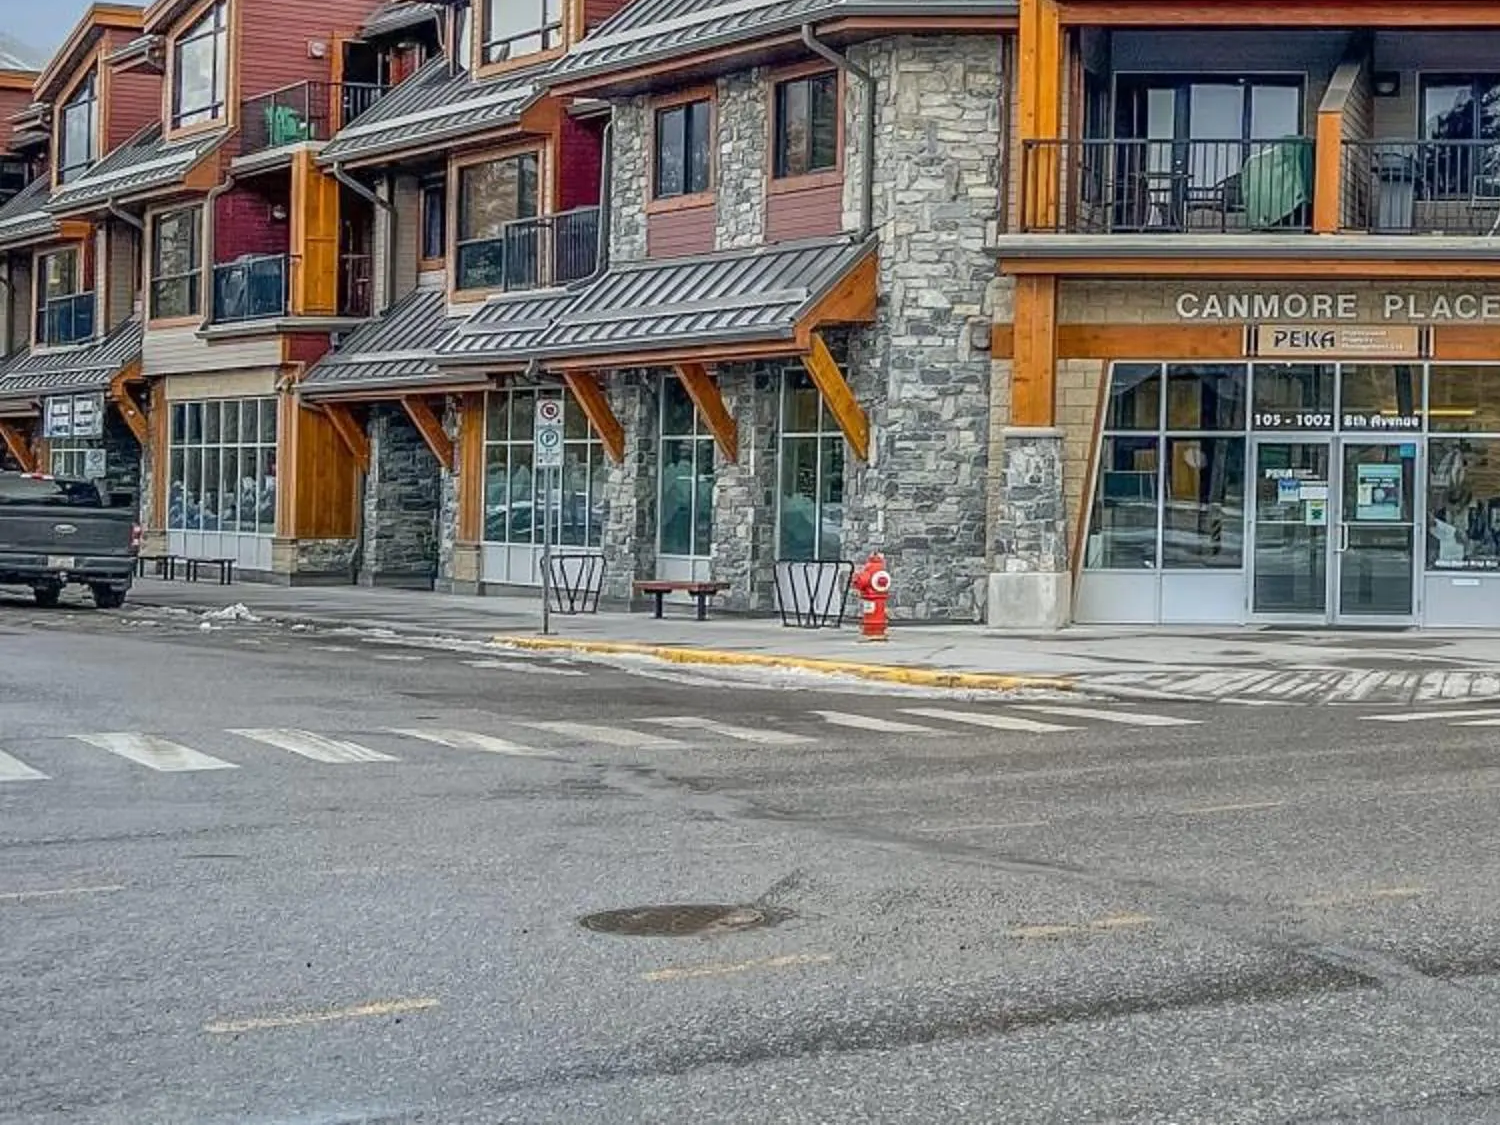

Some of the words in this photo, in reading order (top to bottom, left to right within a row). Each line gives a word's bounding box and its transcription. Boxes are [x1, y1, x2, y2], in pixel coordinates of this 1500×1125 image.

[1176, 293, 1358, 319] CANMORE
[1273, 330, 1335, 348] PEKA
[1295, 413, 1332, 426] 1002
[1343, 413, 1367, 426] 8th
[1370, 414, 1419, 427] Avenue
